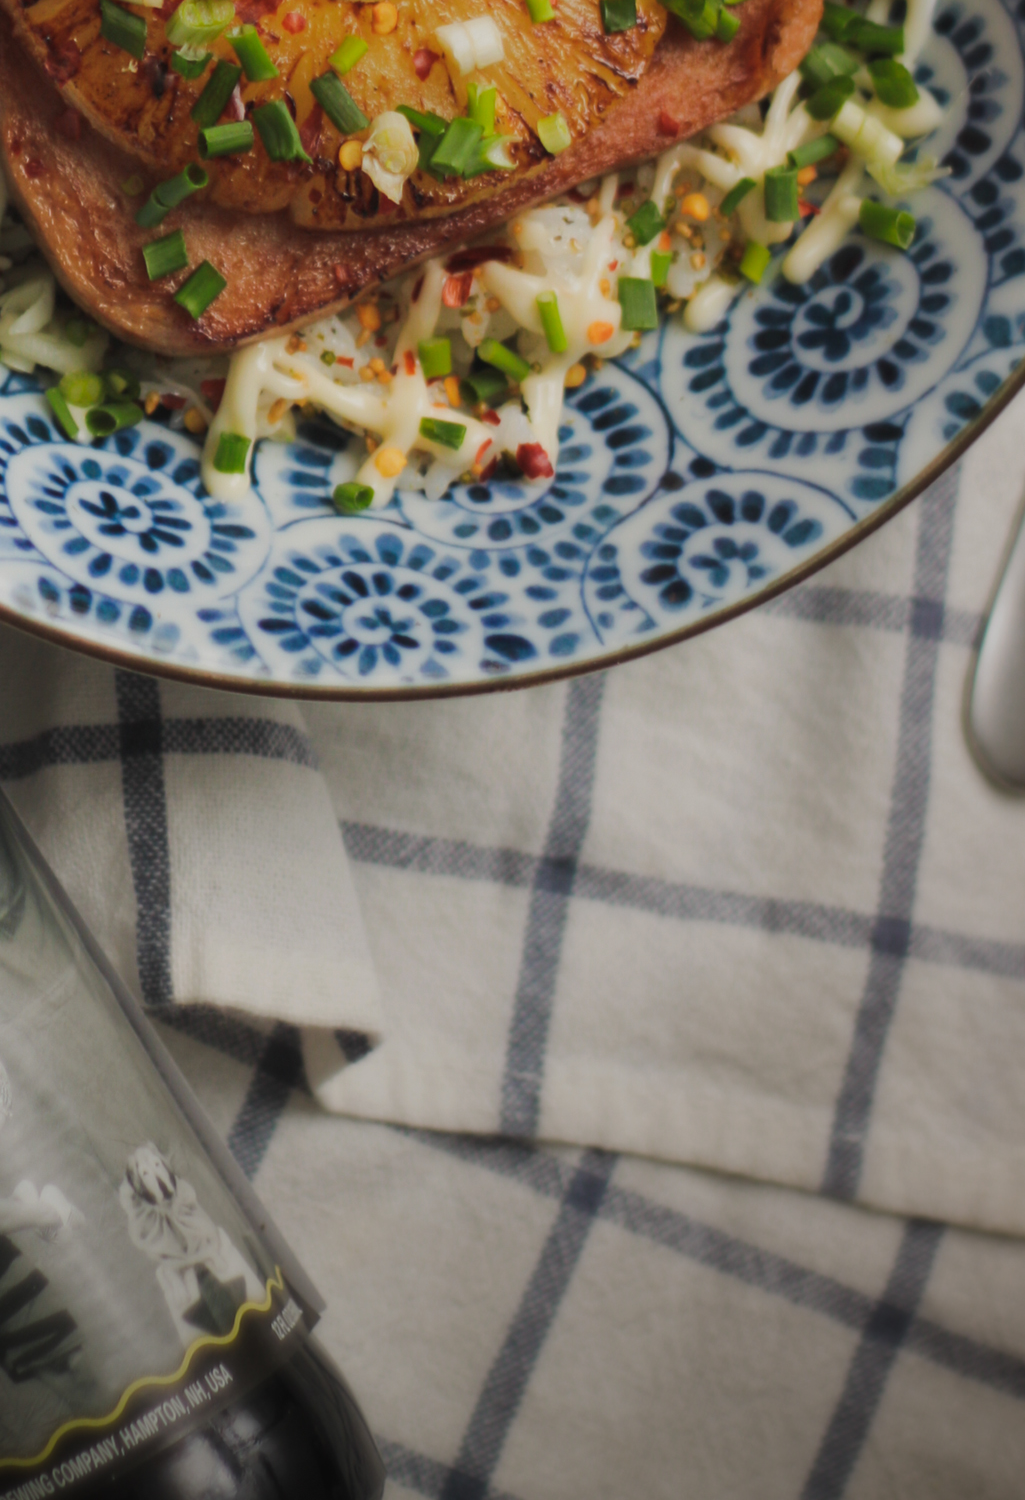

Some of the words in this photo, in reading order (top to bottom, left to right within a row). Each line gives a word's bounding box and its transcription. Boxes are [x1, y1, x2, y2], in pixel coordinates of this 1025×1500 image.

[51, 1433, 125, 1488] COMPANY,
[119, 1394, 191, 1450] HAMPTON,
[183, 1379, 212, 1409] NH,
[203, 1362, 234, 1394] USA
